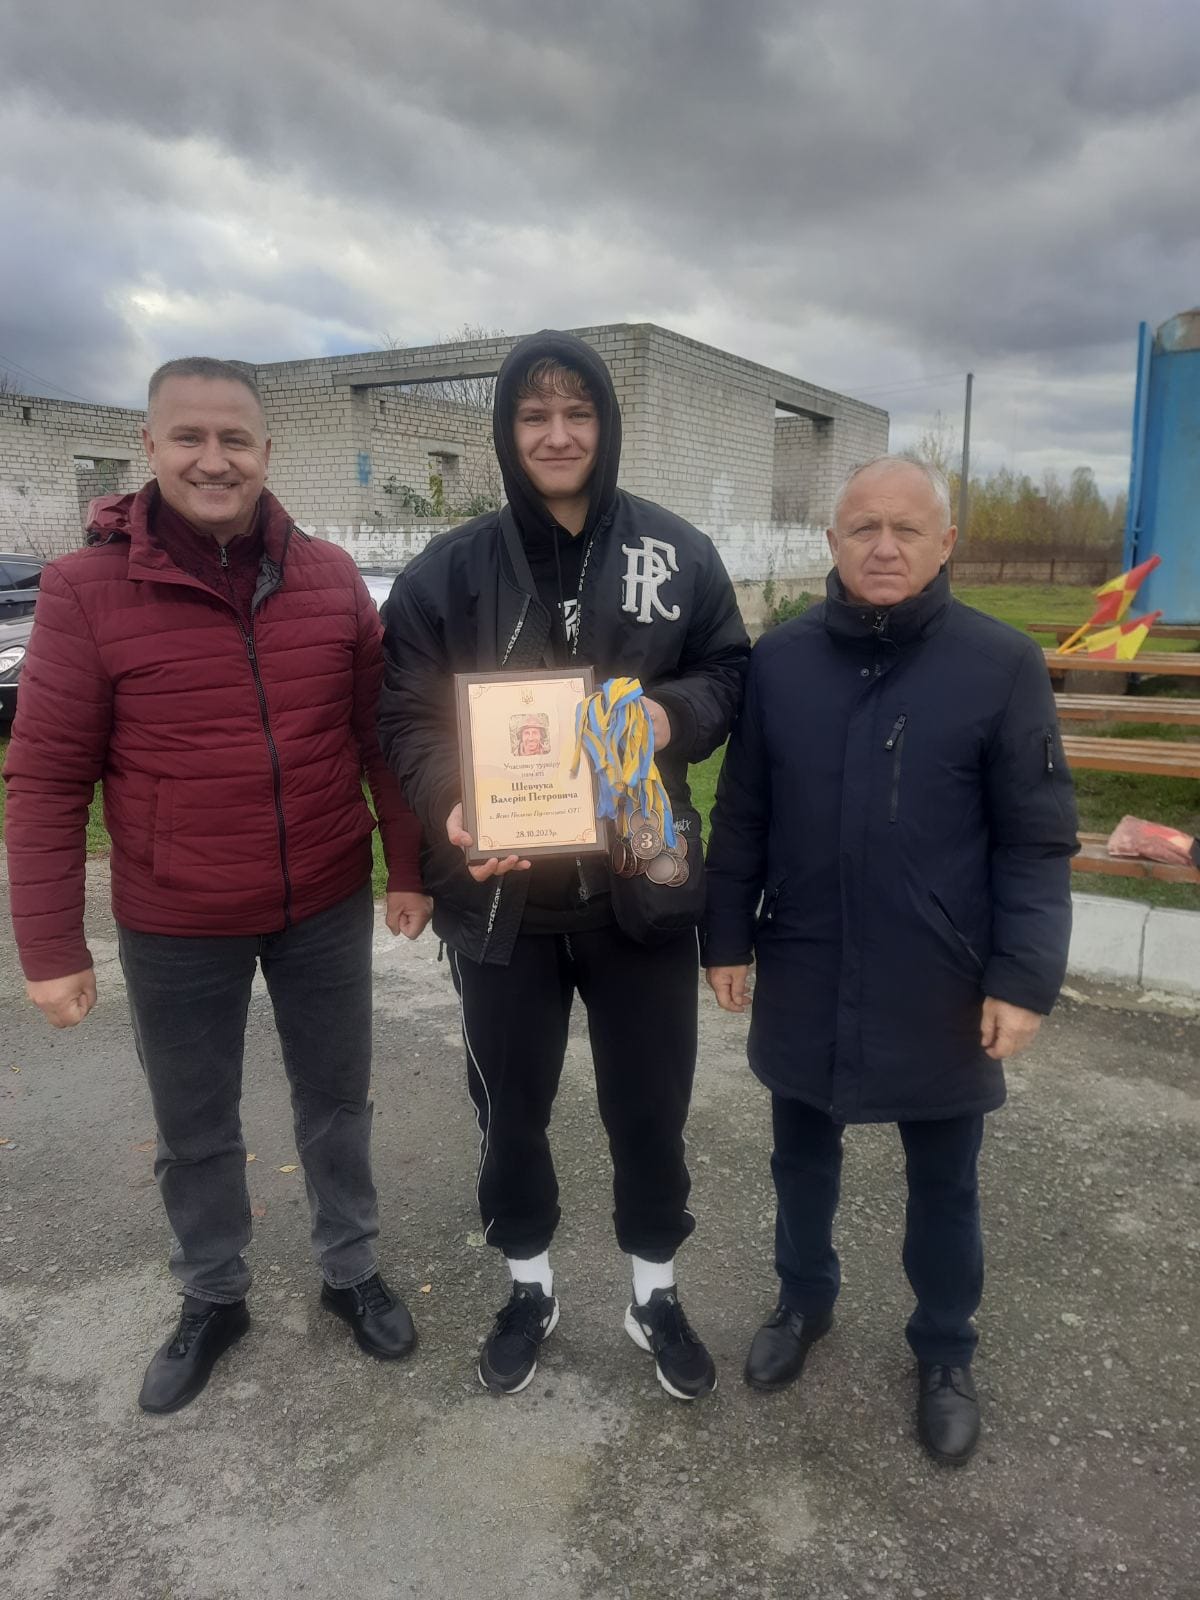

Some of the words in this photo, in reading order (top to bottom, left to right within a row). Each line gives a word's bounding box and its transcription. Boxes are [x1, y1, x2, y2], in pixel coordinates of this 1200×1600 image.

[511, 781, 554, 791] Шевчука
[490, 794, 526, 805] Валерія
[528, 791, 578, 802] Петровича
[641, 832, 653, 849] 3
